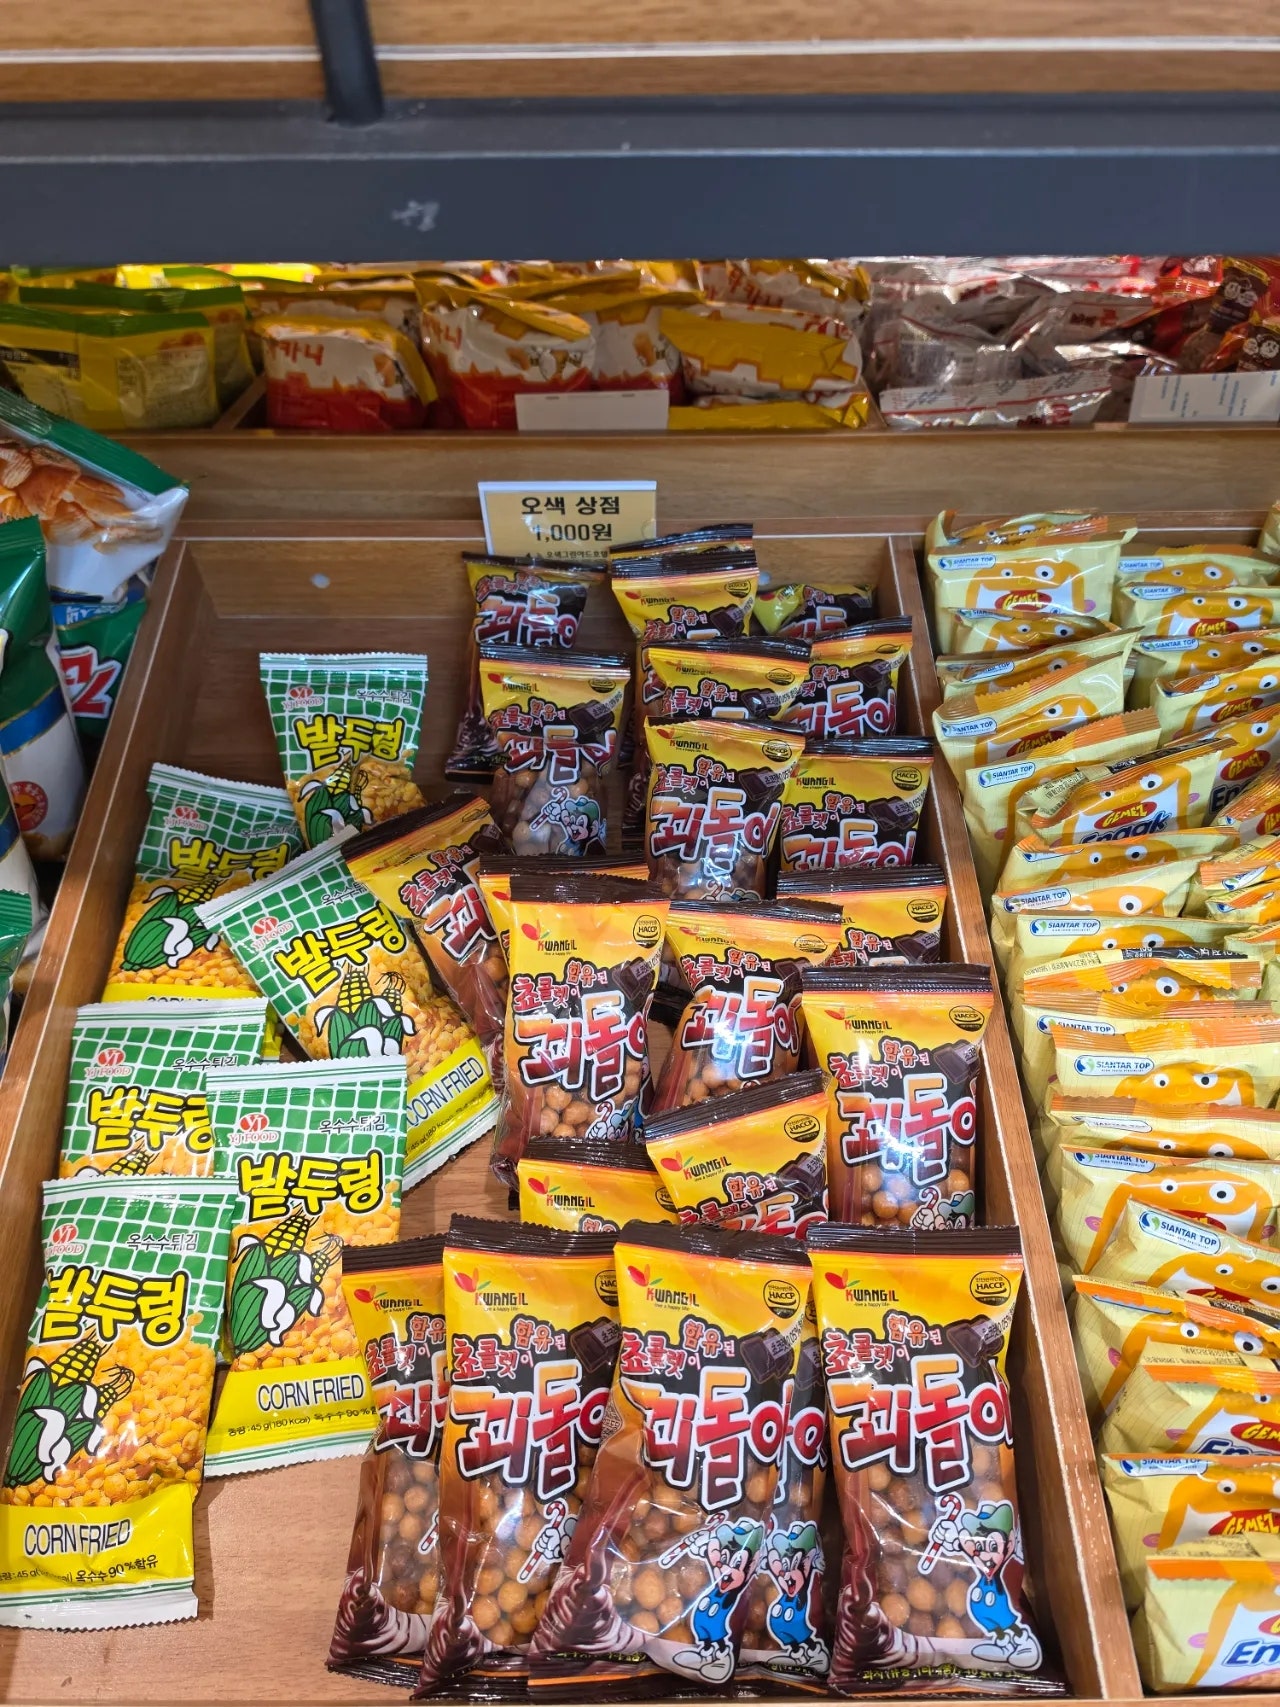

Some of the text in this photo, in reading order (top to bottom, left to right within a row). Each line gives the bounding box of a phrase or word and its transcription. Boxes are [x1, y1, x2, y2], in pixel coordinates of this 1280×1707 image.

[521, 497, 619, 515] 오색 상점
[533, 524, 612, 541] 1,000원
[978, 721, 994, 730] TOP
[294, 714, 405, 771] 밭두렁
[669, 739, 709, 751] KWANGIL
[697, 756, 735, 781] 함유된
[992, 765, 1033, 779] SIANTAR TOP
[796, 776, 837, 786] KWANGIL
[825, 793, 866, 812] 함유된
[1102, 804, 1148, 827] GEMEZ
[650, 787, 782, 877] 꾀돌이
[1021, 891, 1067, 906] SIANTAR TOP
[276, 901, 406, 997] 밭두렁
[537, 939, 577, 952] KWANGIL
[848, 929, 893, 951] 함유된
[728, 948, 772, 973] 함유된
[567, 960, 609, 986] 함유된
[681, 976, 803, 1079] 꾀돌이
[845, 1019, 892, 1030] KWANGIL
[514, 990, 654, 1101] 꾀돌이
[882, 1038, 931, 1067] 함유된
[99, 1067, 131, 1076] FOOD
[406, 1083, 448, 1126] CORN
[441, 1057, 484, 1098] FRIED
[319, 1115, 386, 1134] 옥수수튀김
[789, 1120, 814, 1133] HACCP
[836, 1073, 976, 1187] 꾀돌이
[243, 1133, 279, 1142] FOOD
[684, 1156, 732, 1180] KWANGIL
[238, 1149, 383, 1222] 밭두렁
[726, 1175, 778, 1202] 함유된
[546, 1195, 595, 1207] KWANGIL
[127, 1234, 198, 1251] 옥수수튀김
[1161, 1221, 1217, 1247] SIANTAR TOP
[646, 1287, 700, 1307] KWANGIL
[845, 1290, 899, 1302] KWANGIL
[976, 1282, 1005, 1290] HACCP
[40, 1265, 189, 1346] 밭두렁
[373, 1298, 423, 1311] KWANGIL
[474, 1292, 528, 1306] KWANGIL
[514, 1318, 567, 1354] 함유된
[684, 1318, 735, 1358] 함유된
[886, 1314, 943, 1348] 함유된
[258, 1375, 364, 1411] CORN FRIED
[827, 1354, 1014, 1493] 꾀돌이
[1242, 1424, 1280, 1440] GEM
[620, 1366, 795, 1511] 꾀돌이
[25, 1519, 130, 1555] CORN FRIED
